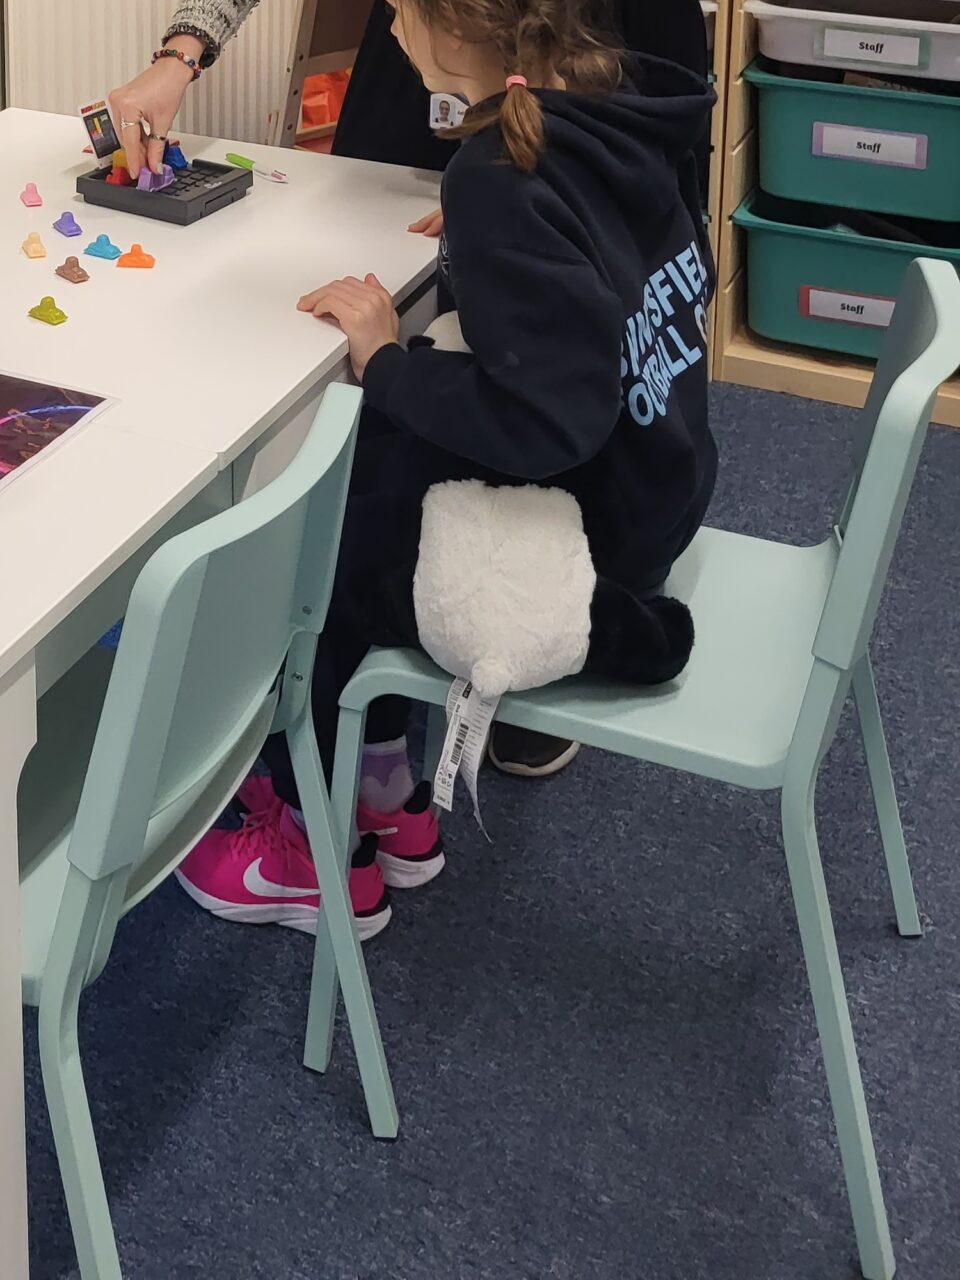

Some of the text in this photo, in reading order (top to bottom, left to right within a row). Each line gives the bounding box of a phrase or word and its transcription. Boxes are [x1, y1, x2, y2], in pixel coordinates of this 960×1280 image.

[858, 41, 884, 54] Staff
[856, 141, 882, 154] Staff
[840, 303, 865, 316] Staff
